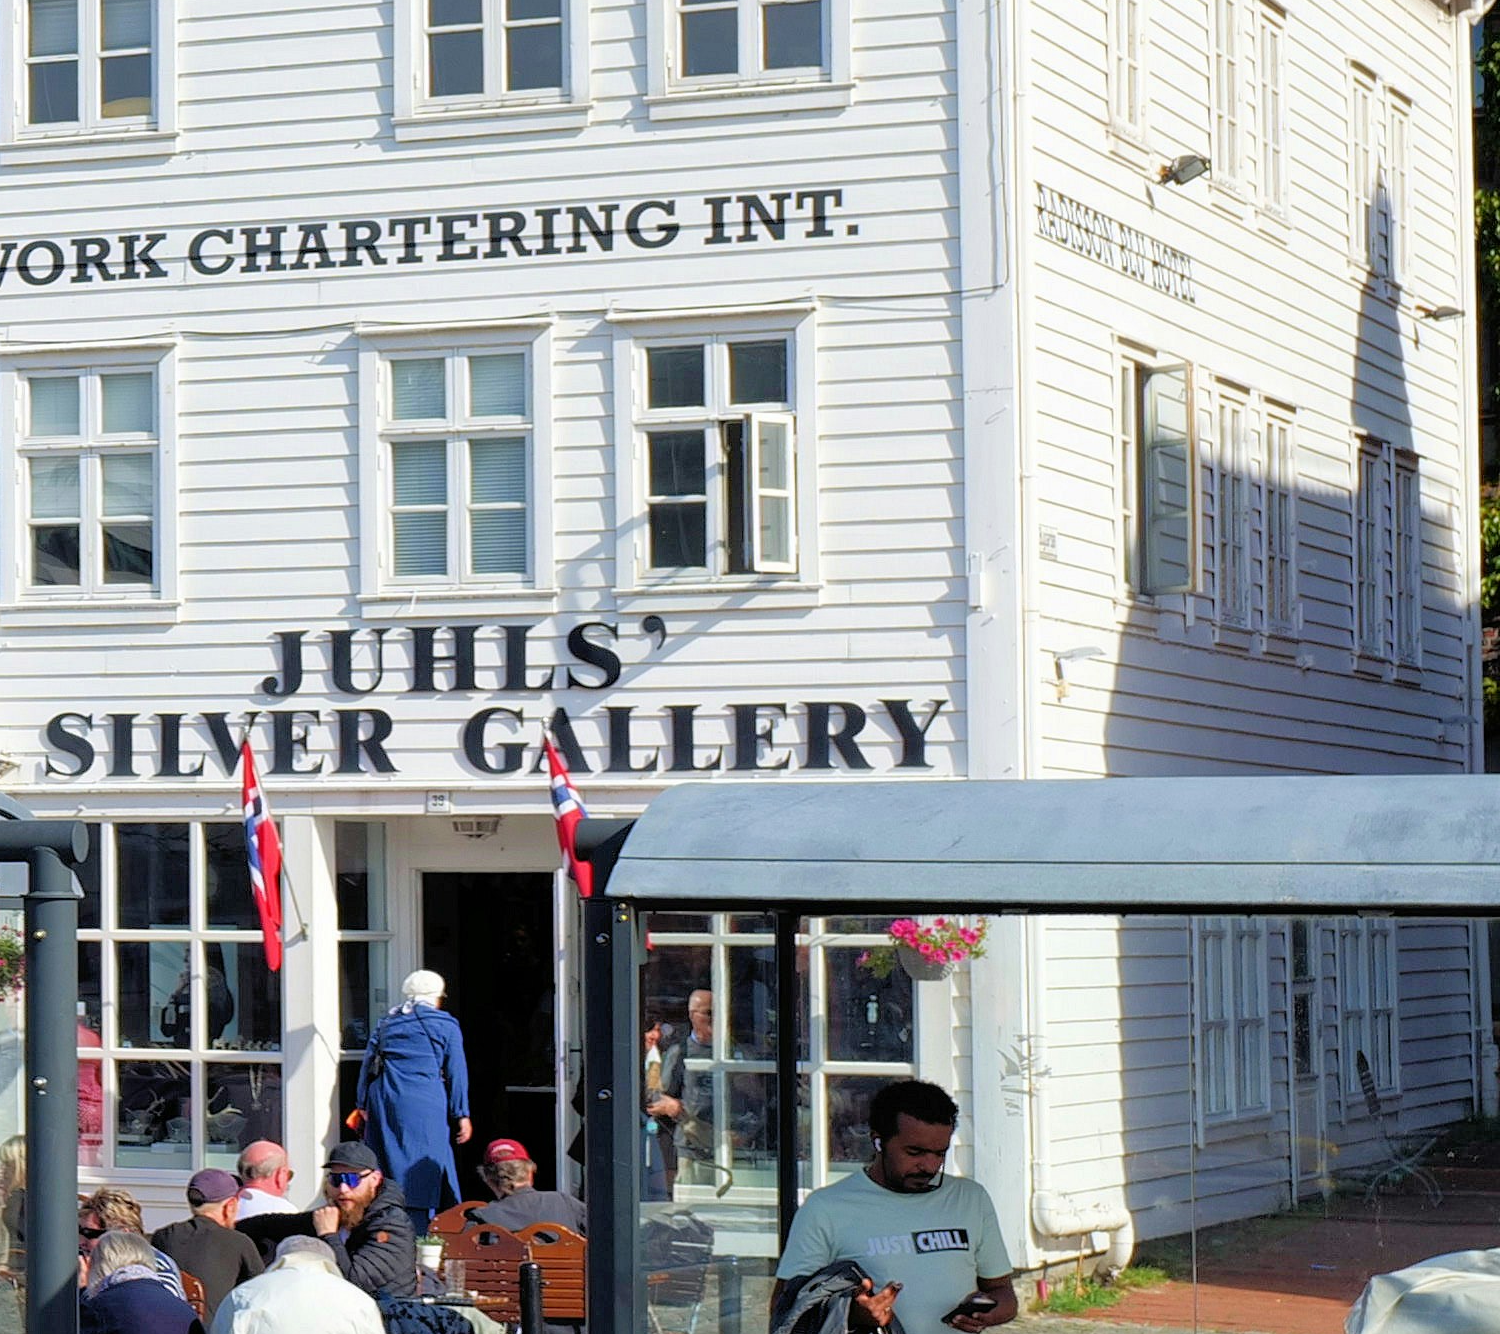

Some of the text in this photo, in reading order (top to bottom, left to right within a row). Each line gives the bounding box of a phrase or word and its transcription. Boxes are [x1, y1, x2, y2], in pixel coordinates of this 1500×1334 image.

[187, 198, 679, 276] CHARTERING
[704, 189, 860, 246] INT.
[1036, 182, 1197, 303] RADISSON BLU HOTEL
[44, 698, 947, 779] SILVER GALLERY
[866, 1236, 913, 1257] JUST
